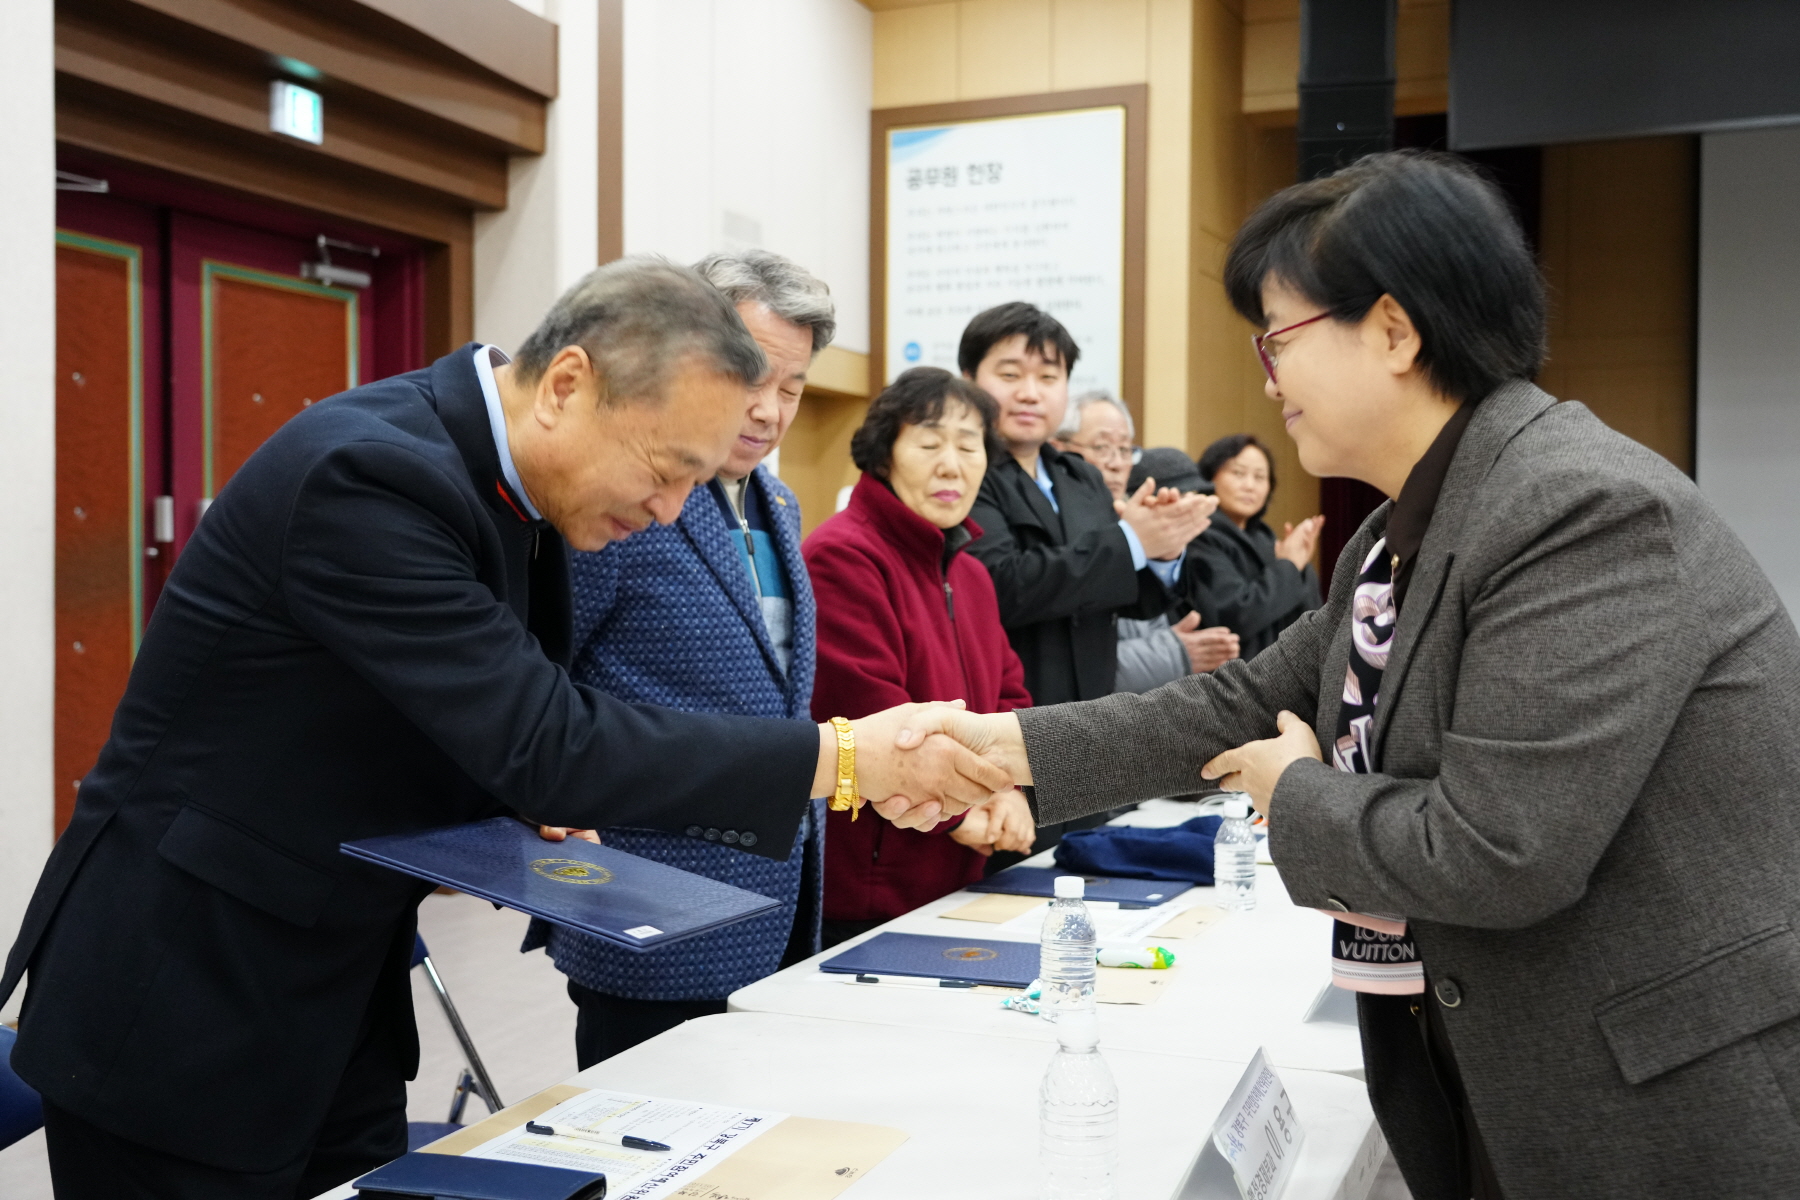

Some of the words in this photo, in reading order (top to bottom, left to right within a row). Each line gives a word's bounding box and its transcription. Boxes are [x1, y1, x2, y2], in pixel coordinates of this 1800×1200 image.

[906, 166, 959, 190] 공무원
[1339, 940, 1415, 962] VUITTON
[703, 1133, 738, 1151] 강북구
